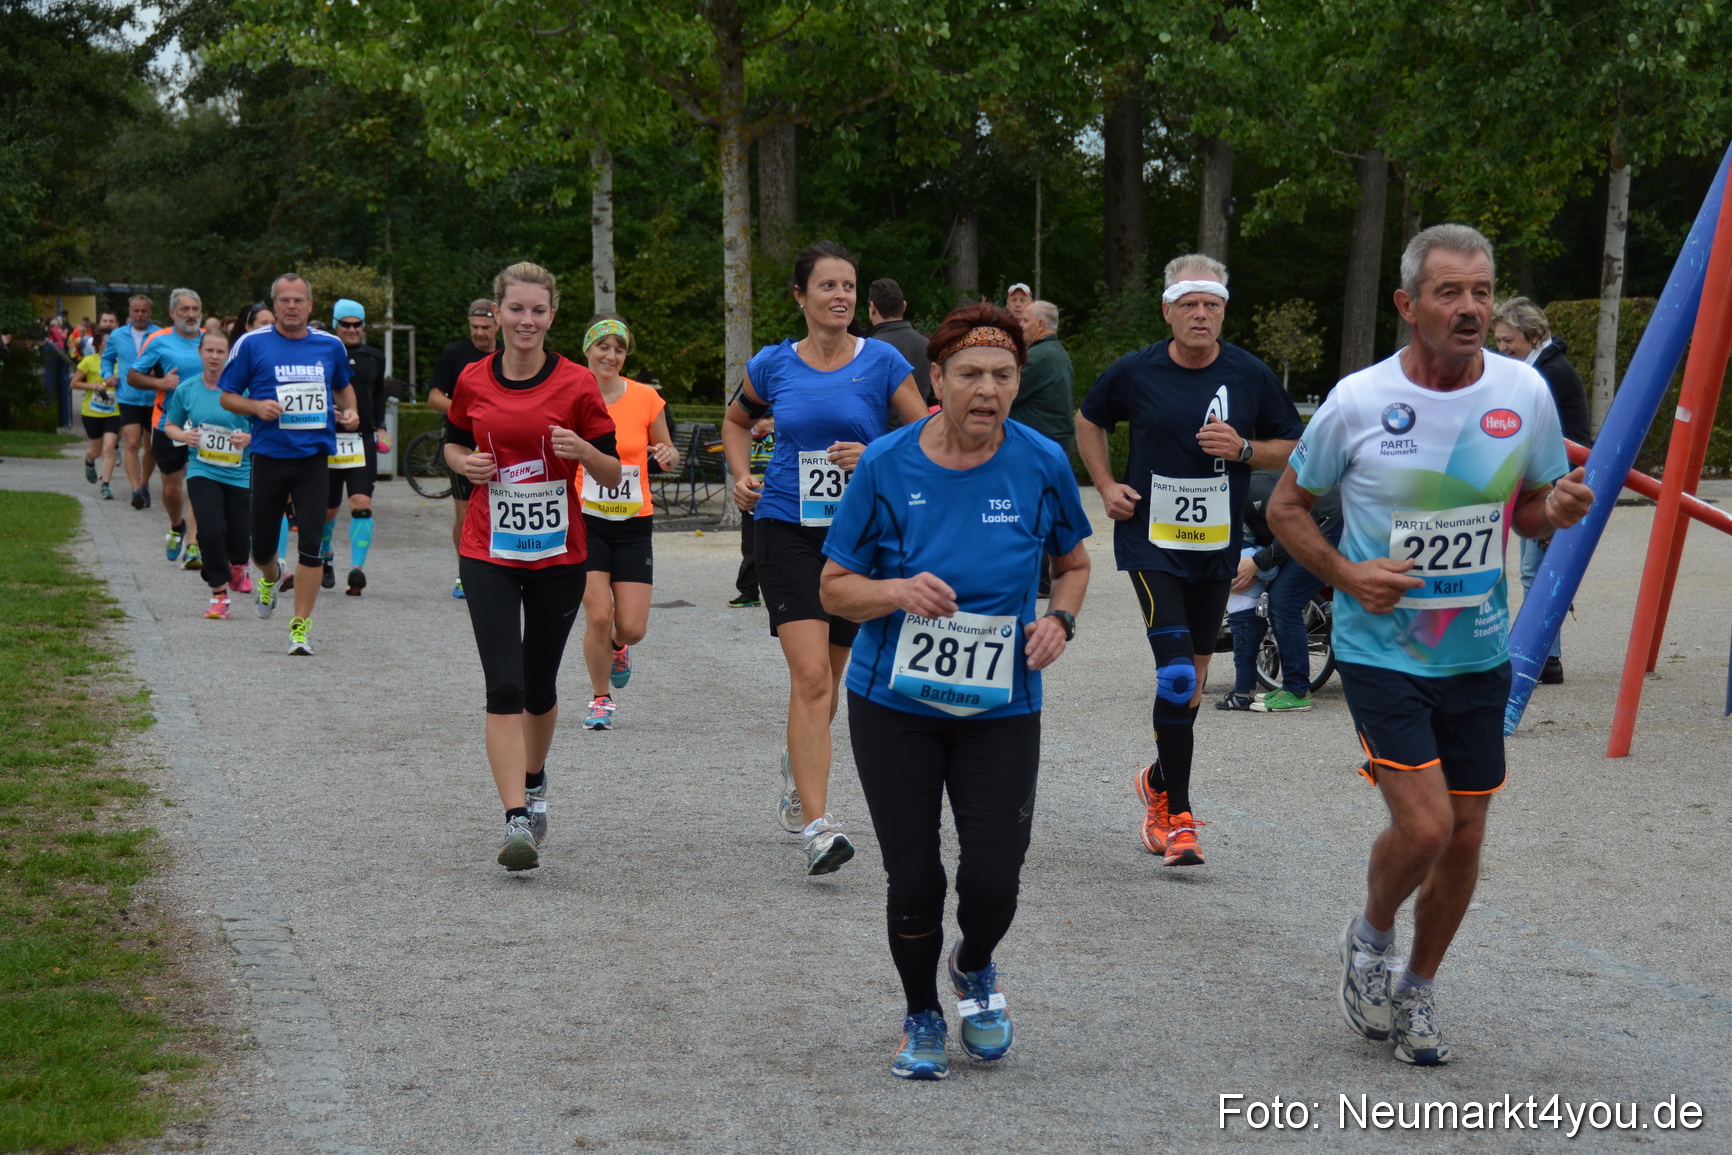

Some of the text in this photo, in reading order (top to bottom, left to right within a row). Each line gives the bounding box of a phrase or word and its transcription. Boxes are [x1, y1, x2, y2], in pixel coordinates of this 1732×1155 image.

[274, 365, 325, 376] HUBER
[285, 394, 323, 411] 2175
[1486, 416, 1517, 430] Hervis
[206, 434, 232, 451] 301
[1380, 439, 1418, 449] PARTL
[1380, 448, 1418, 456] Neumarkt
[802, 458, 829, 466] PARTL
[509, 466, 531, 478] DEHN
[490, 489, 553, 499] PARTL Neumarkt
[1153, 482, 1217, 493] PARTL Neumarkt
[988, 499, 1012, 510] TSG
[1175, 496, 1207, 523] 25
[497, 500, 561, 530] 2555
[982, 512, 1020, 523] Laaber
[1395, 515, 1486, 530] PARTL Neumarkt
[1175, 529, 1206, 541] Janke
[517, 538, 542, 549] Julia
[1403, 528, 1493, 571] 2227
[1433, 579, 1463, 594] Karl
[906, 614, 997, 636] PARTL Neumarkt
[908, 632, 1004, 680] 2817
[920, 684, 981, 705] Barbara
